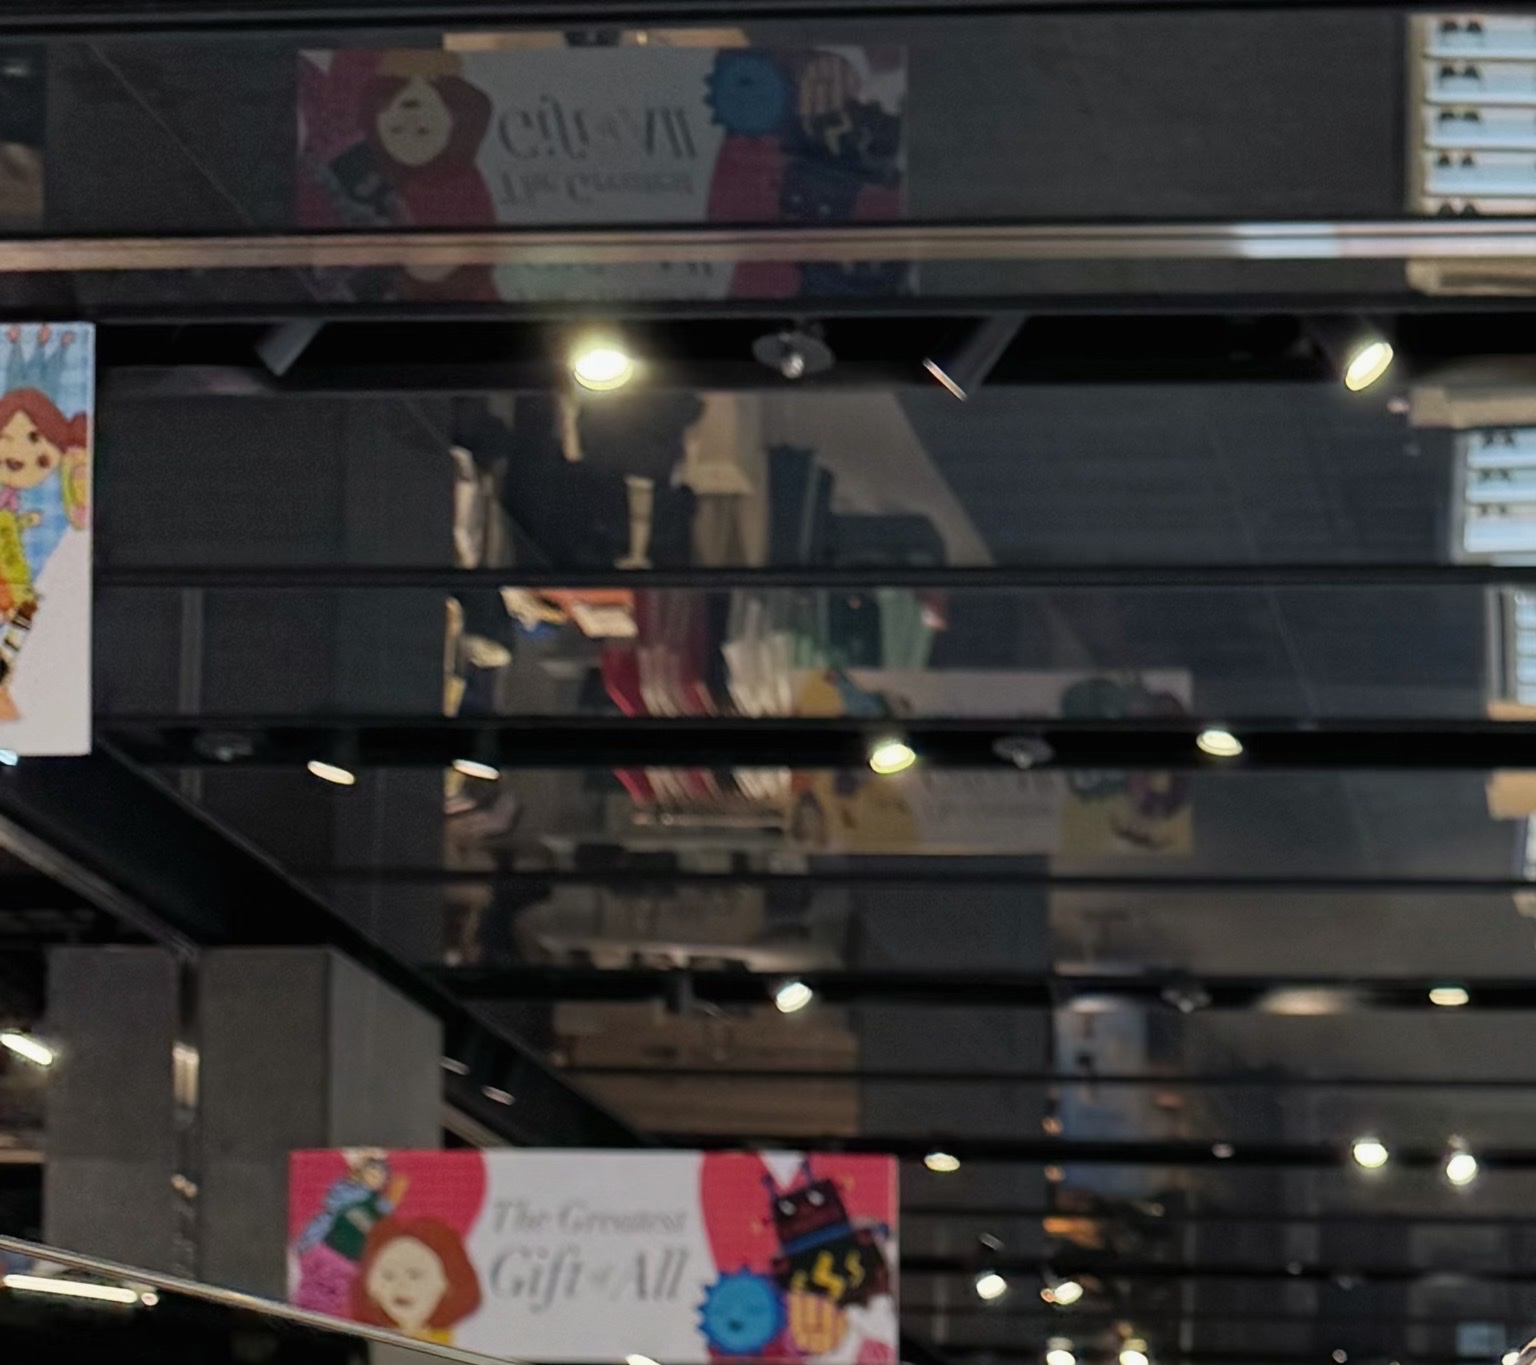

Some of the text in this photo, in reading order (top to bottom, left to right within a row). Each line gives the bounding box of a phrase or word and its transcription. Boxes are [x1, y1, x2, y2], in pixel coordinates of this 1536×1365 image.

[493, 1198, 689, 1235] The Greatest
[489, 1244, 583, 1315] Gift
[608, 1245, 690, 1302] All
